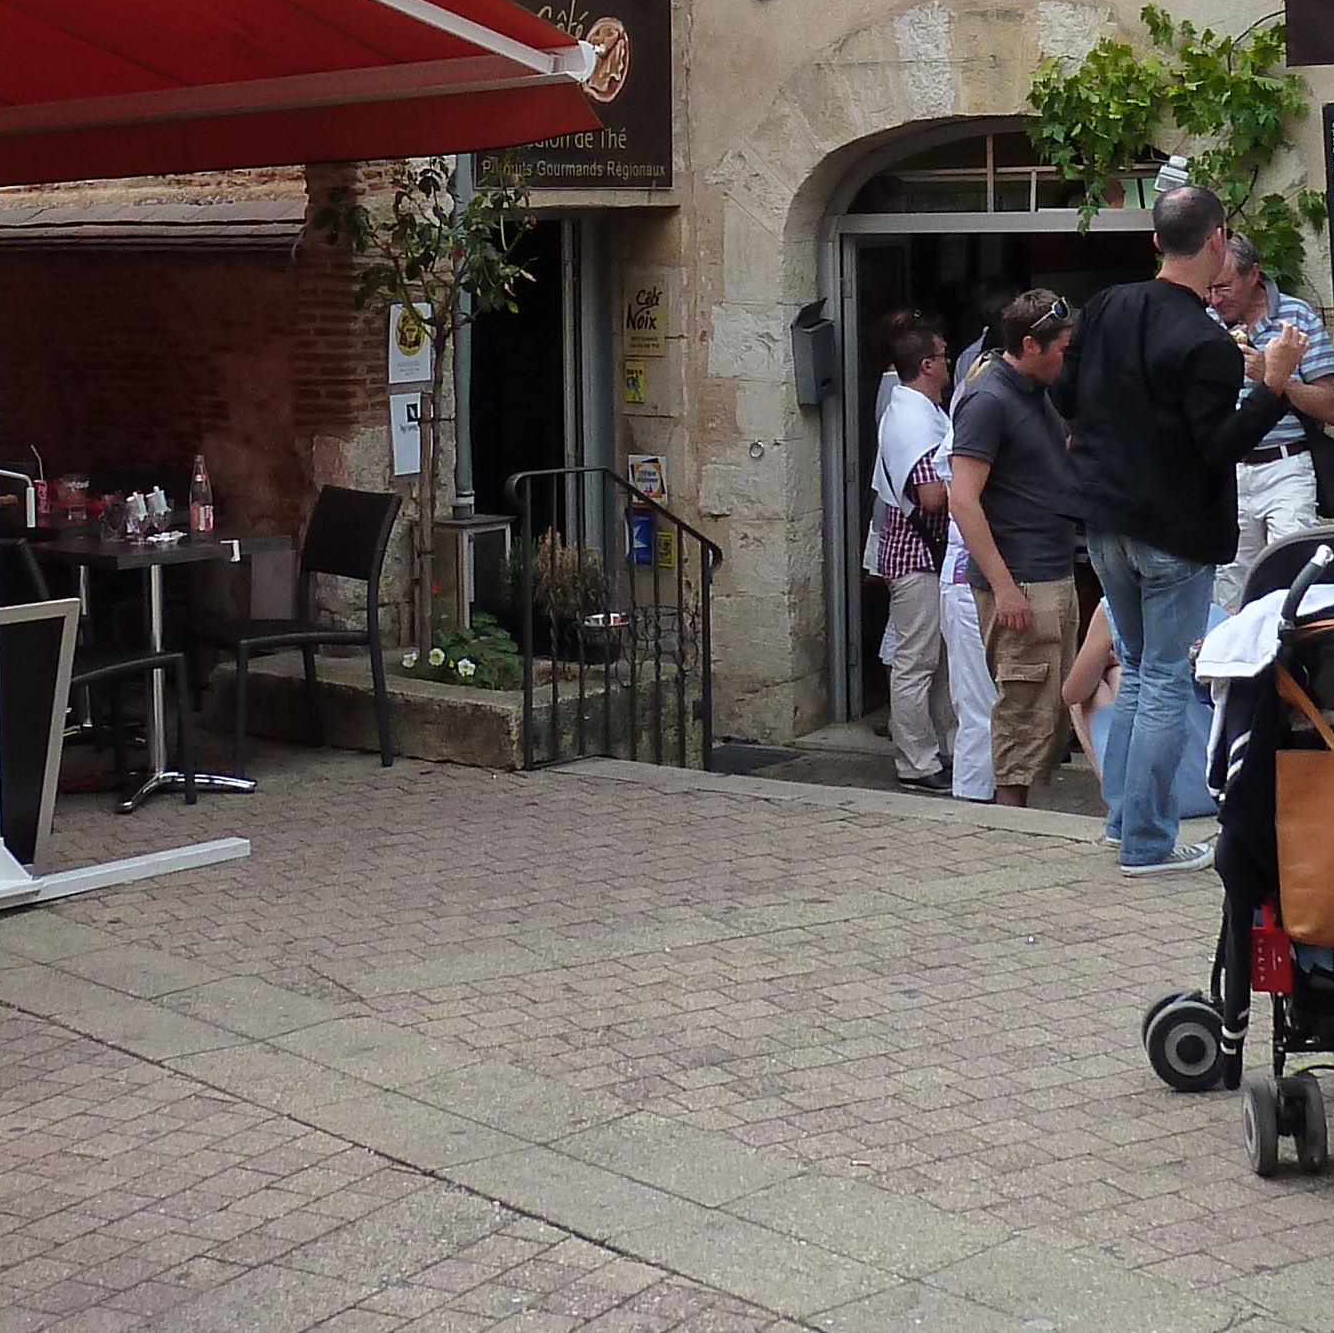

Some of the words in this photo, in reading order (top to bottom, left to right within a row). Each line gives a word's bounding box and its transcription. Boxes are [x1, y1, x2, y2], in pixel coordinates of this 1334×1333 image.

[574, 132, 595, 150] de
[536, 159, 604, 178] Gourmands
[607, 159, 666, 181] Régionaux
[626, 303, 658, 331] Noix
